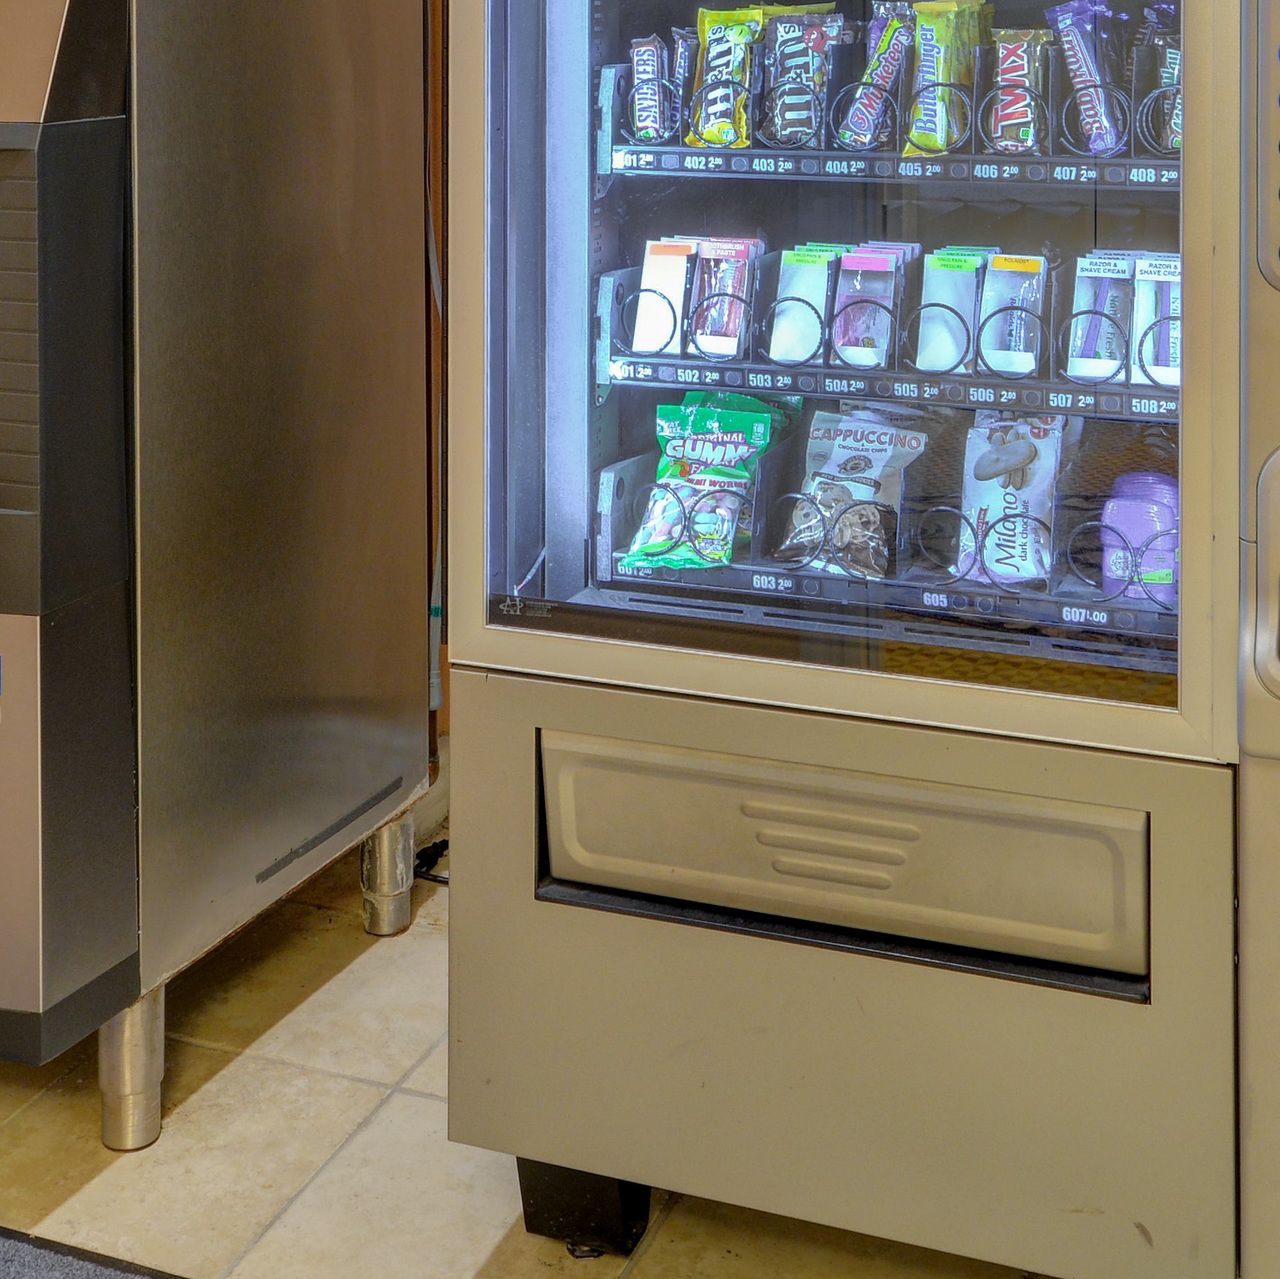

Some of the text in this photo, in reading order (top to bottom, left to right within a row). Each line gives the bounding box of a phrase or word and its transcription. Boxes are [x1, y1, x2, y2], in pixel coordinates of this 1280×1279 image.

[851, 28, 913, 130] 3 Musketeers
[912, 24, 941, 135] Butterfinger
[635, 49, 657, 126] SNICKERS
[992, 42, 1031, 137] TWIX
[684, 156, 723, 170] 402 2.00
[752, 158, 793, 173] 403 2.00
[825, 160, 865, 174] 404 2.00
[898, 163, 941, 176] 405 2.00
[974, 164, 1019, 178] 406 2.00
[1053, 166, 1096, 182] 407 2.00
[1129, 169, 1178, 183] 408 2.00
[1103, 267, 1127, 276] CREAM
[1139, 269, 1162, 277] SHAVE
[677, 369, 720, 383] 502 2.00
[749, 373, 792, 388] 503 2.00
[825, 379, 865, 393] 504 2.00
[894, 382, 939, 398] 505 2.00
[969, 388, 1017, 402] 506 2.00
[1049, 392, 1095, 408] 507 2.00
[1131, 399, 1176, 414] 508 2.00
[809, 427, 922, 451] CAPPUCCINO
[838, 443, 870, 452] CHOCOLATE
[994, 492, 1020, 573] Milano
[1017, 540, 1028, 561] dark
[752, 575, 792, 590] 603 2.00
[923, 592, 948, 608] 605
[1062, 607, 1086, 623] 607
